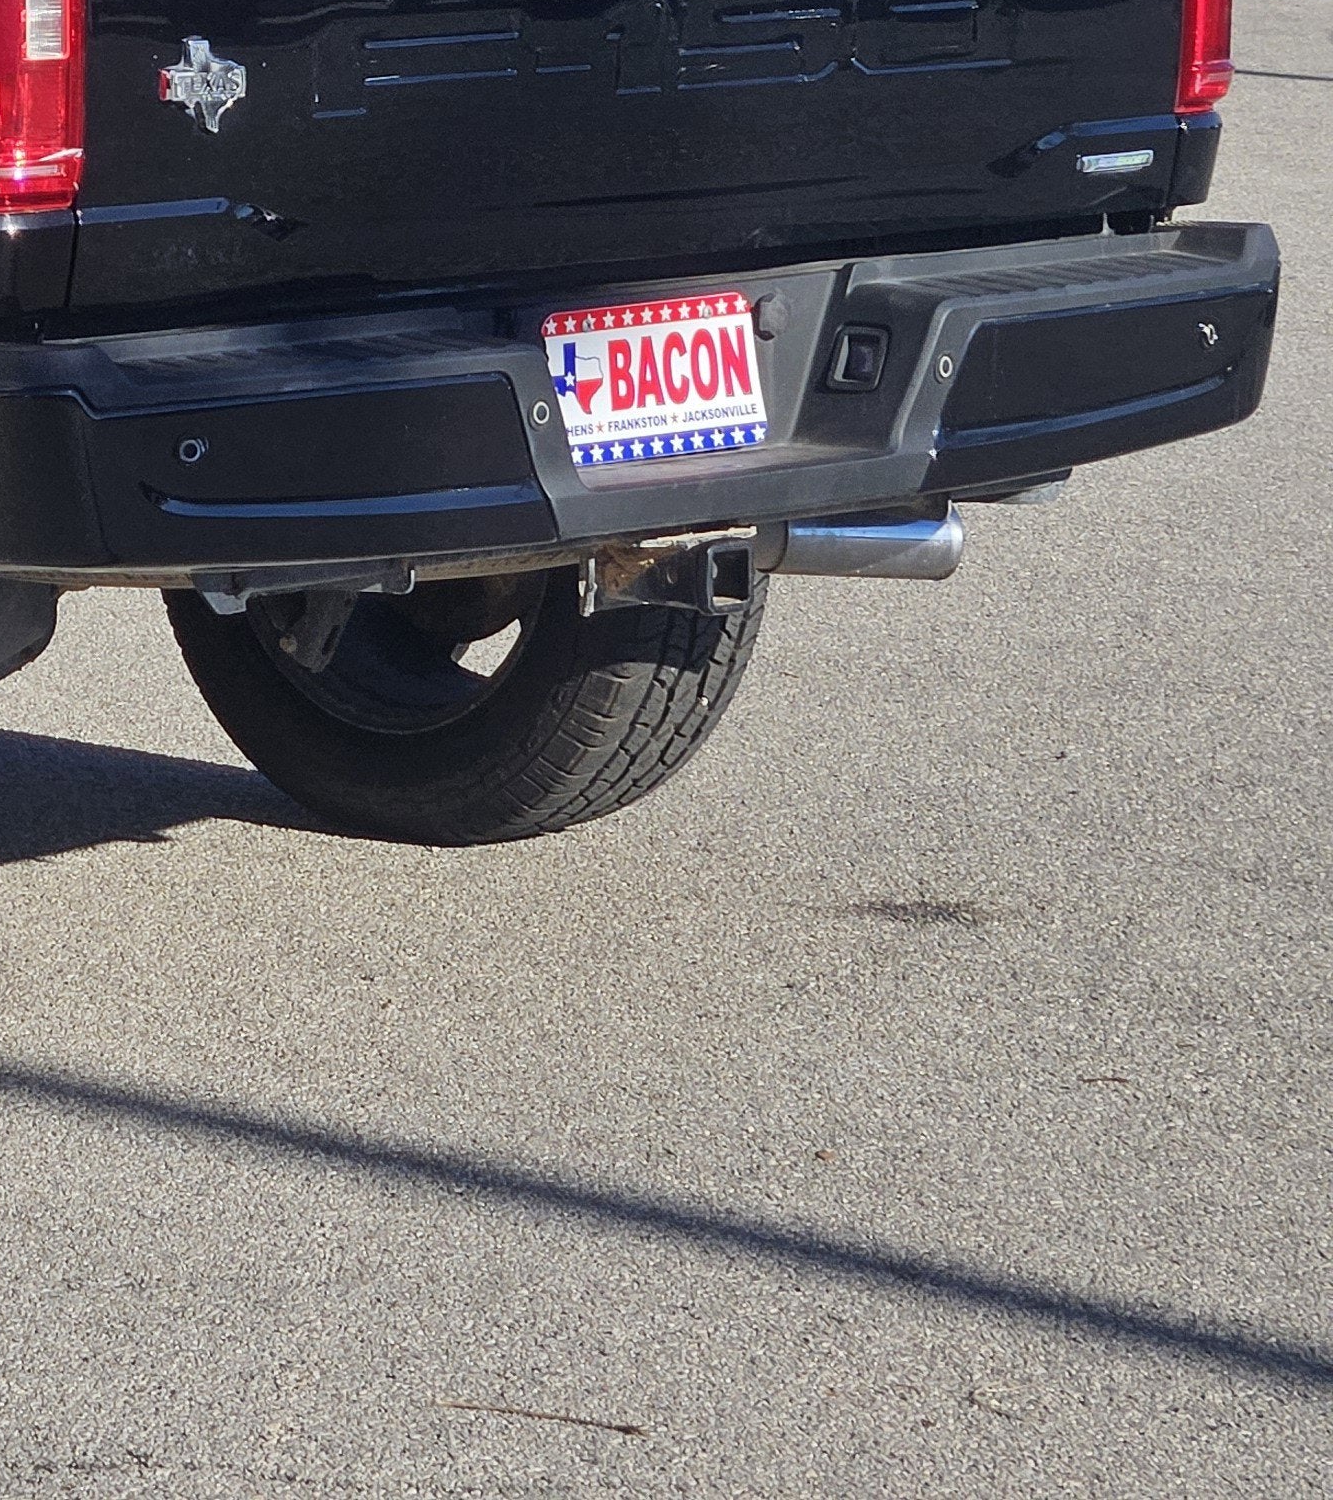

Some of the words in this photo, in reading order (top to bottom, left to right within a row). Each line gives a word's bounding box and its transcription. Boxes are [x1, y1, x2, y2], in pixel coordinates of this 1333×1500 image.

[174, 69, 242, 99] TEXAS
[608, 325, 753, 411] BACON
[566, 421, 594, 437] HENS
[608, 414, 668, 432] FRANKSTON
[681, 403, 758, 424] JACKSONVILLE
